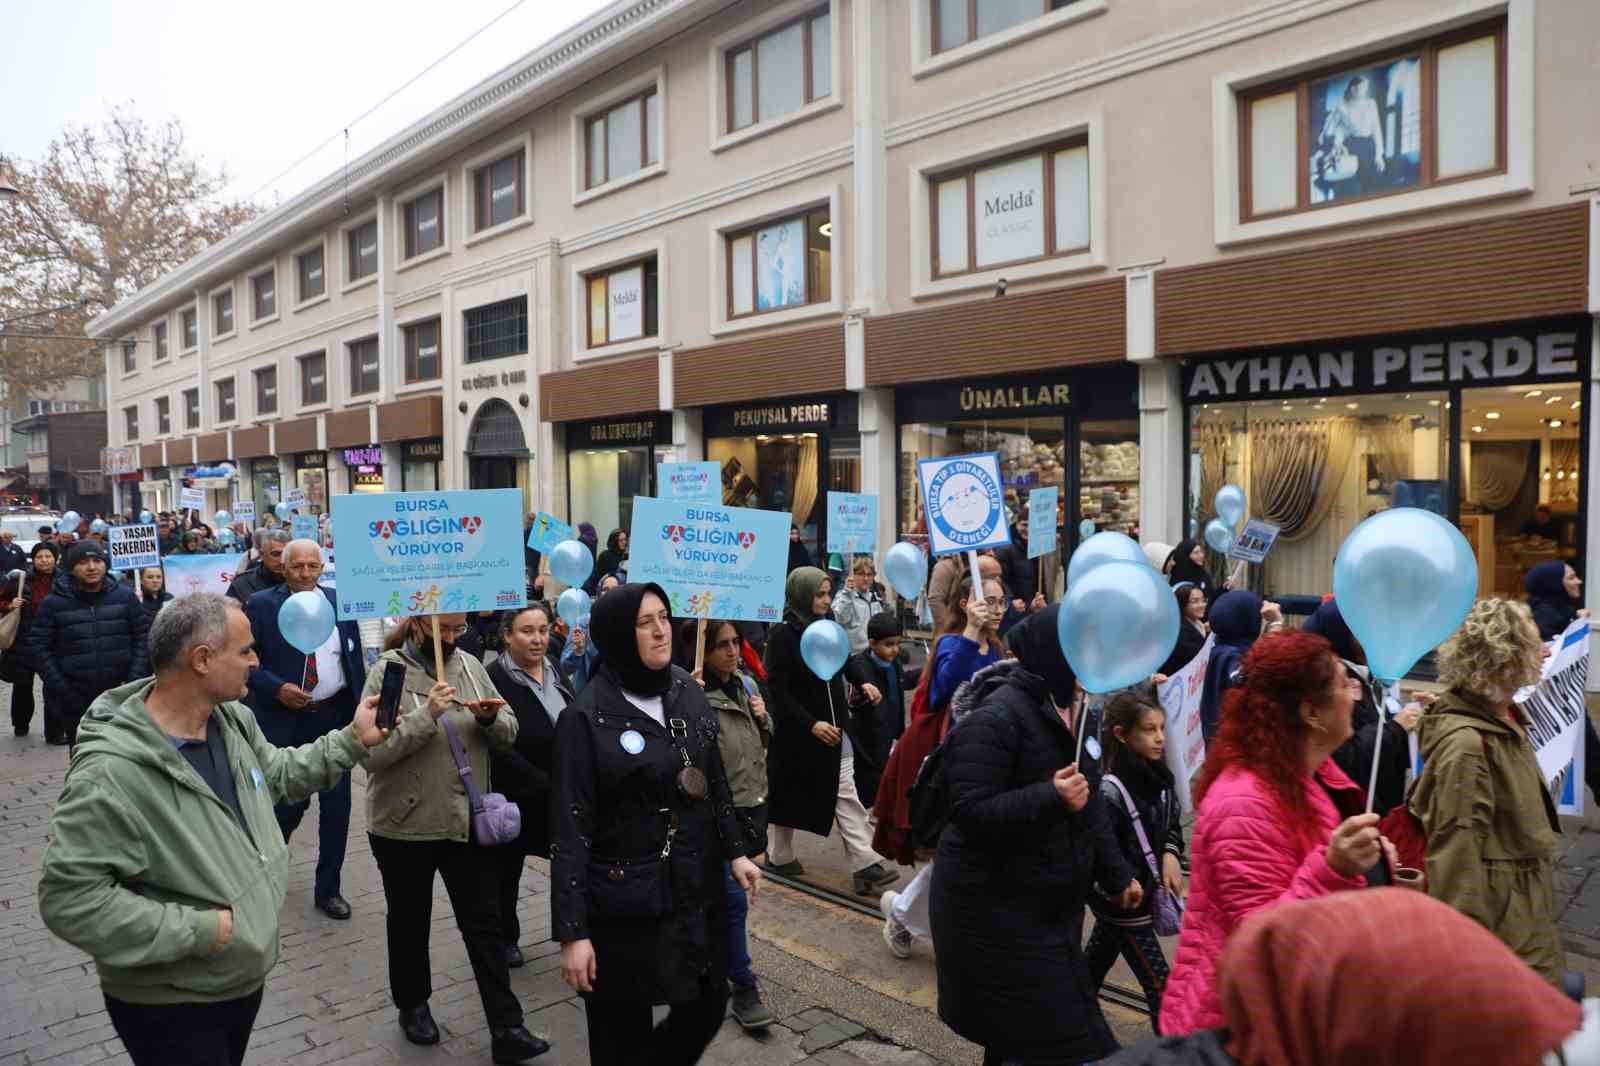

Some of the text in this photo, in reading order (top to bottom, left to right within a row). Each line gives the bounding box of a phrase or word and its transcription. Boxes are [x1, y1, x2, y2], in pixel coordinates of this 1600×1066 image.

[1189, 332, 1578, 397] AYHAN PERDE
[959, 384, 1071, 410] ÜNALLAR
[790, 403, 828, 423] PERDE
[394, 499, 449, 513] BURSA
[686, 508, 731, 523] BURSA
[388, 541, 464, 557] YÜRÜYOR
[674, 546, 738, 565] YÜRÜYOR
